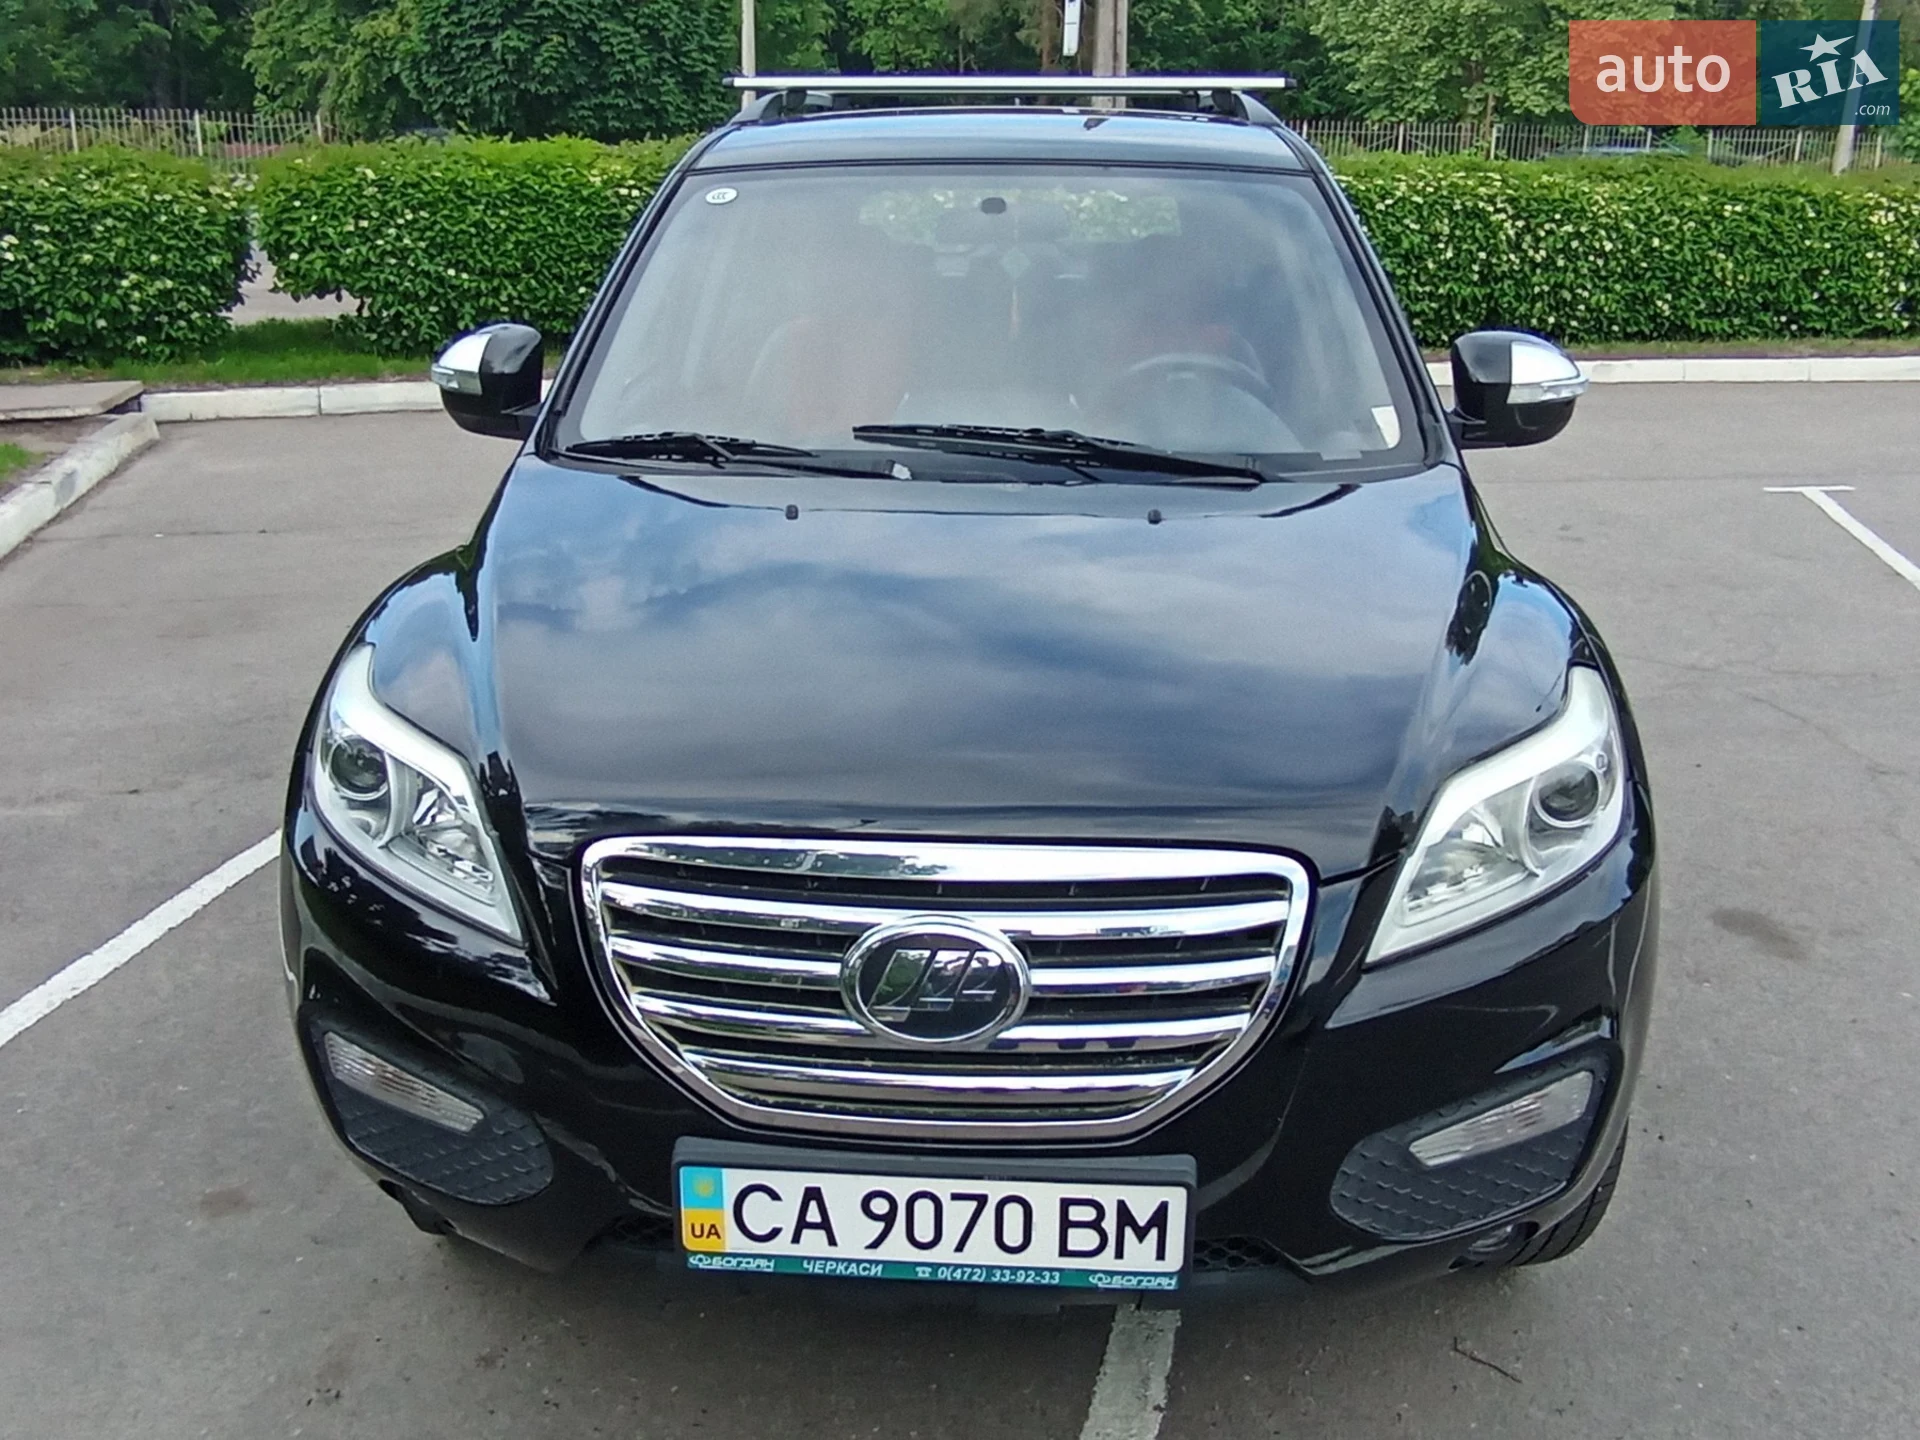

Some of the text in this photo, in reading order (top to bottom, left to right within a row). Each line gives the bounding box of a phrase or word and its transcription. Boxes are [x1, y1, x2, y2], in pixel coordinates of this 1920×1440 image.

[690, 1222, 721, 1240] UA
[733, 1183, 1169, 1261] CA 9070 BM
[802, 1260, 883, 1277] ЧЕРКАСИ
[937, 1265, 986, 1283] 0(472)
[991, 1270, 1060, 1284] 33-92-33
